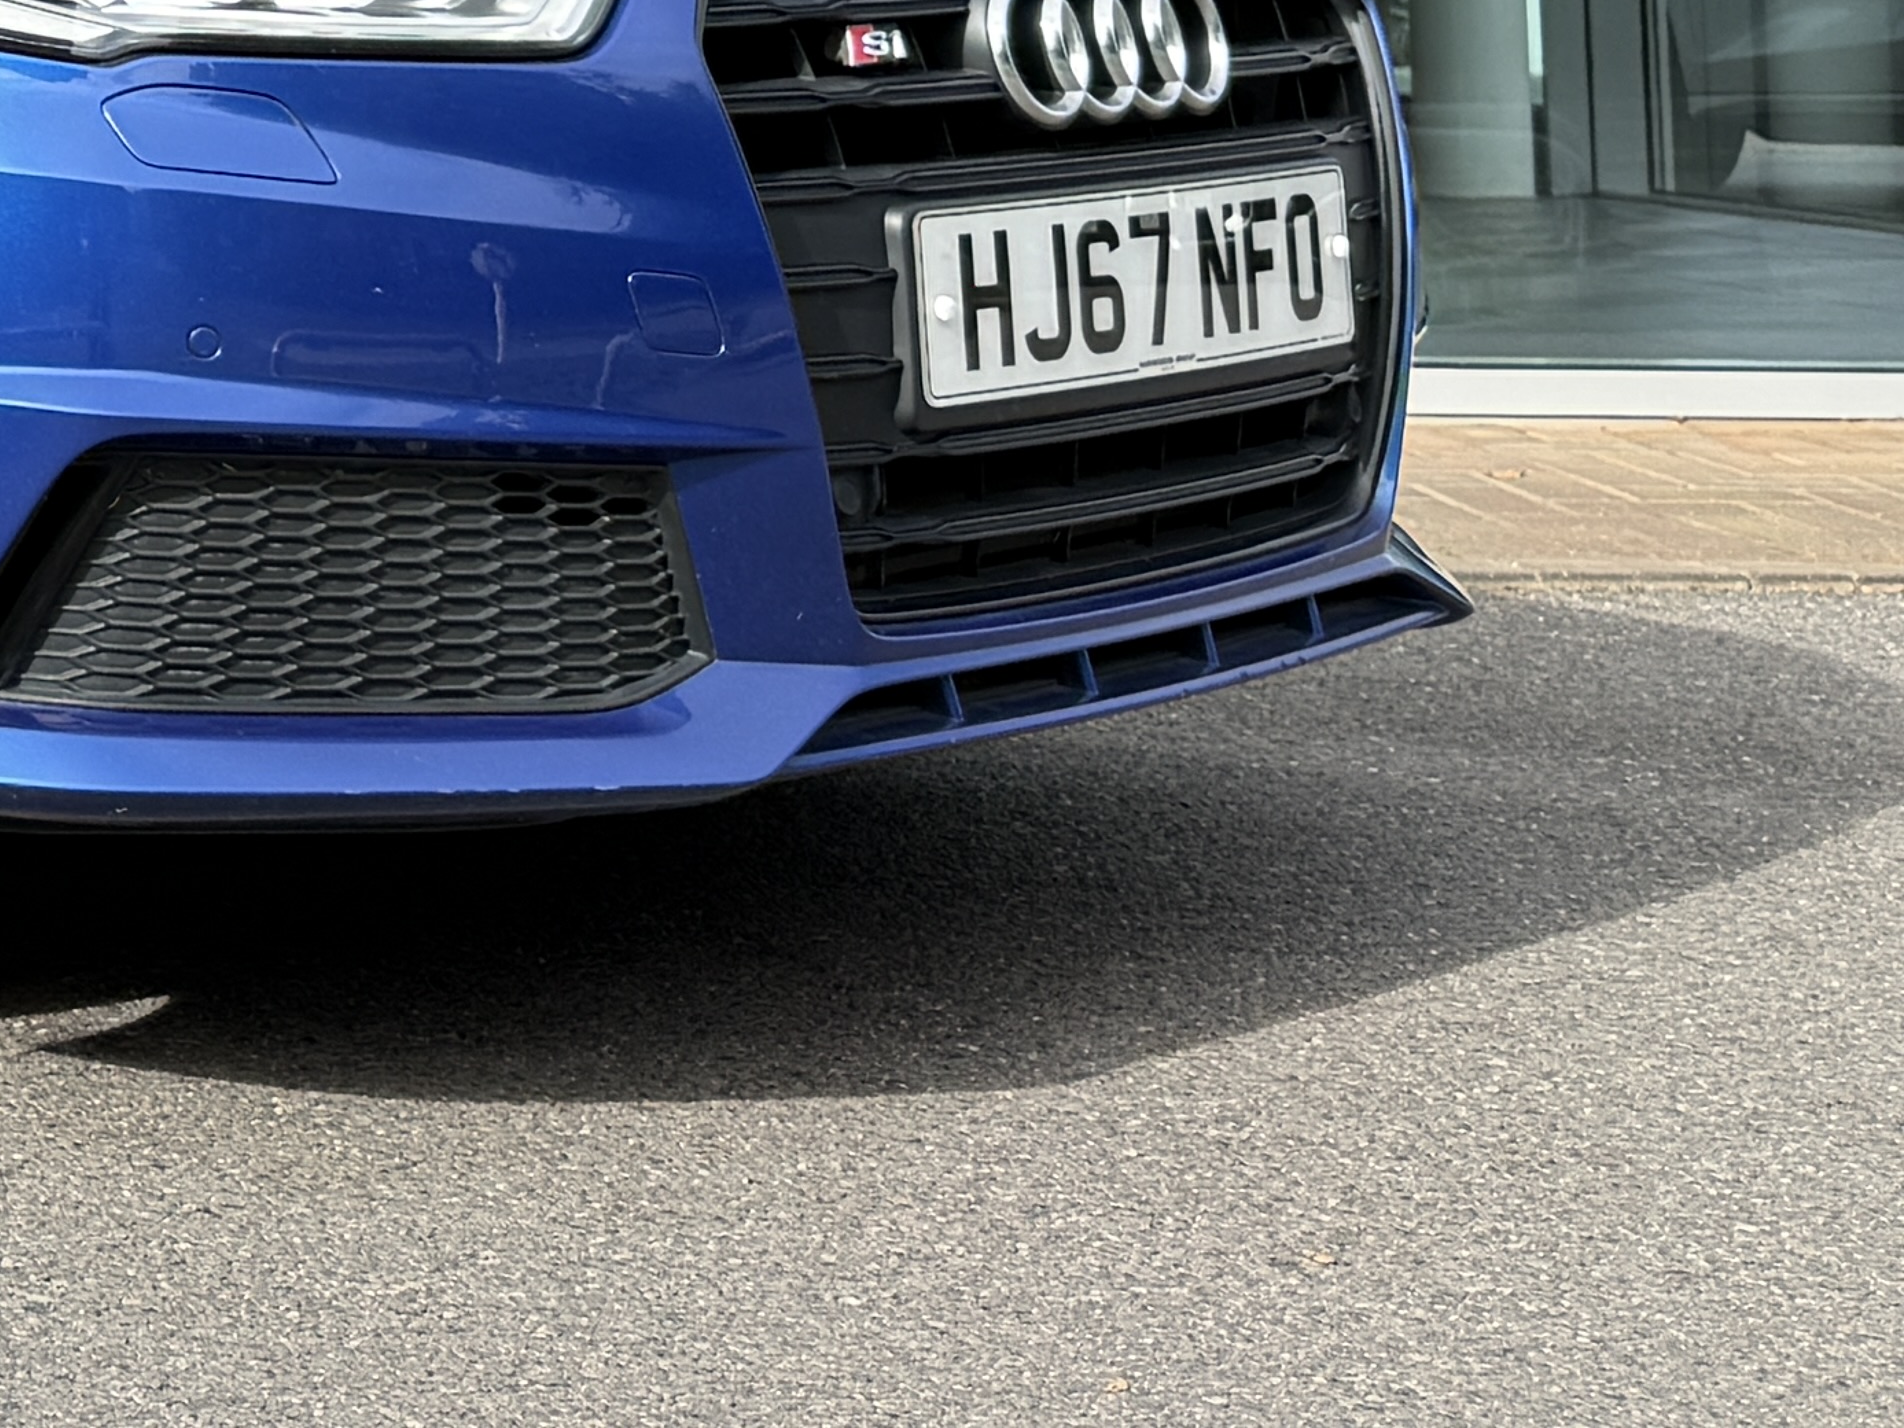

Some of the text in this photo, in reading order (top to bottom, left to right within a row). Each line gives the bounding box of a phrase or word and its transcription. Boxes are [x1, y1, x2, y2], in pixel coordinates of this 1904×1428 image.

[861, 29, 908, 59] S1
[957, 192, 1323, 372] HJ67 NFO
